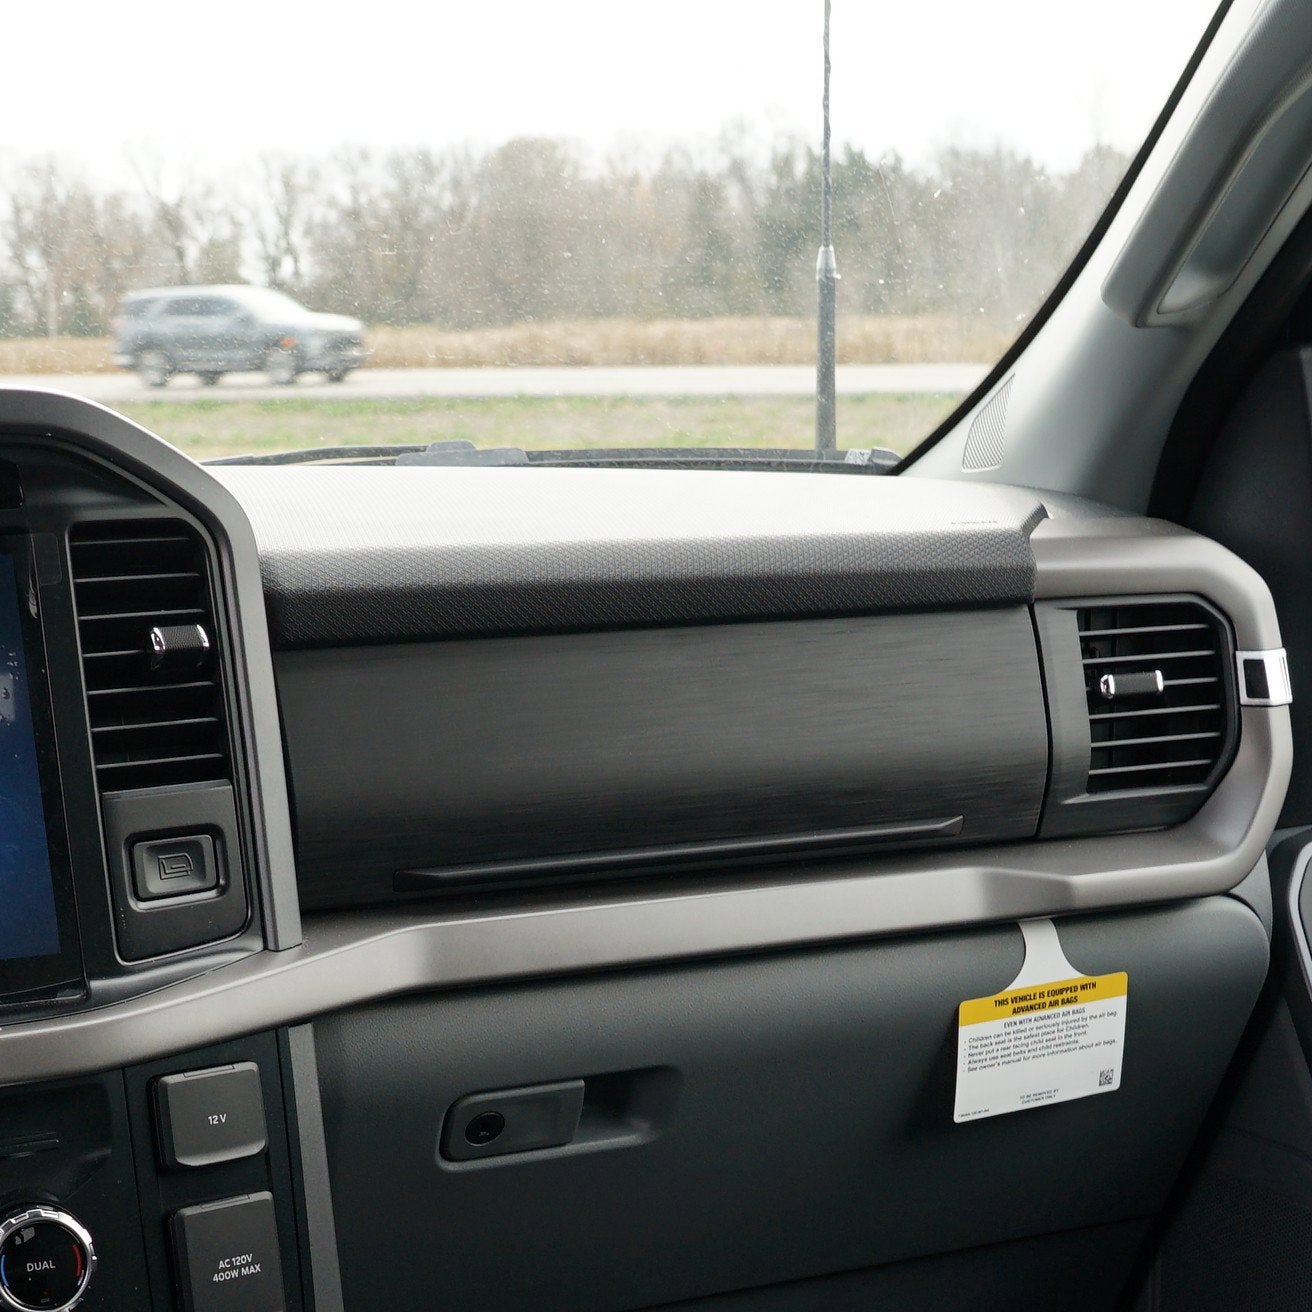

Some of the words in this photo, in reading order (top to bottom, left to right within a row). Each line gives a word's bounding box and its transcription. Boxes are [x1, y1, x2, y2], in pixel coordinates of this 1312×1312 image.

[994, 998, 1009, 1008] THIS
[1011, 992, 1037, 1004] VEHICLE
[1039, 990, 1045, 999] IS
[1047, 985, 1079, 998] EQUIPPED
[1080, 981, 1097, 991] WITH
[1012, 1002, 1047, 1015] ADVANCED
[1049, 1000, 1059, 1008] AIR
[1061, 996, 1078, 1006] BAGS
[1003, 1021, 1017, 1029] EVEN
[1019, 1017, 1032, 1025] WITH
[1033, 1012, 1061, 1022] ADVANCED
[1062, 1010, 1070, 1018] AIR
[1072, 1007, 1086, 1015] BAGS
[969, 1035, 992, 1043] Children
[1013, 1027, 1028, 1035] killed
[1061, 1017, 1080, 1027] injured
[980, 1041, 993, 1049] back
[968, 1050, 984, 1058] Never
[968, 1056, 988, 1065] Always
[26, 1259, 56, 1273] DUAL
[218, 1257, 231, 1269] AC
[231, 1253, 253, 1267] 120V
[212, 1268, 239, 1283] 400W
[241, 1263, 262, 1276] MAX
